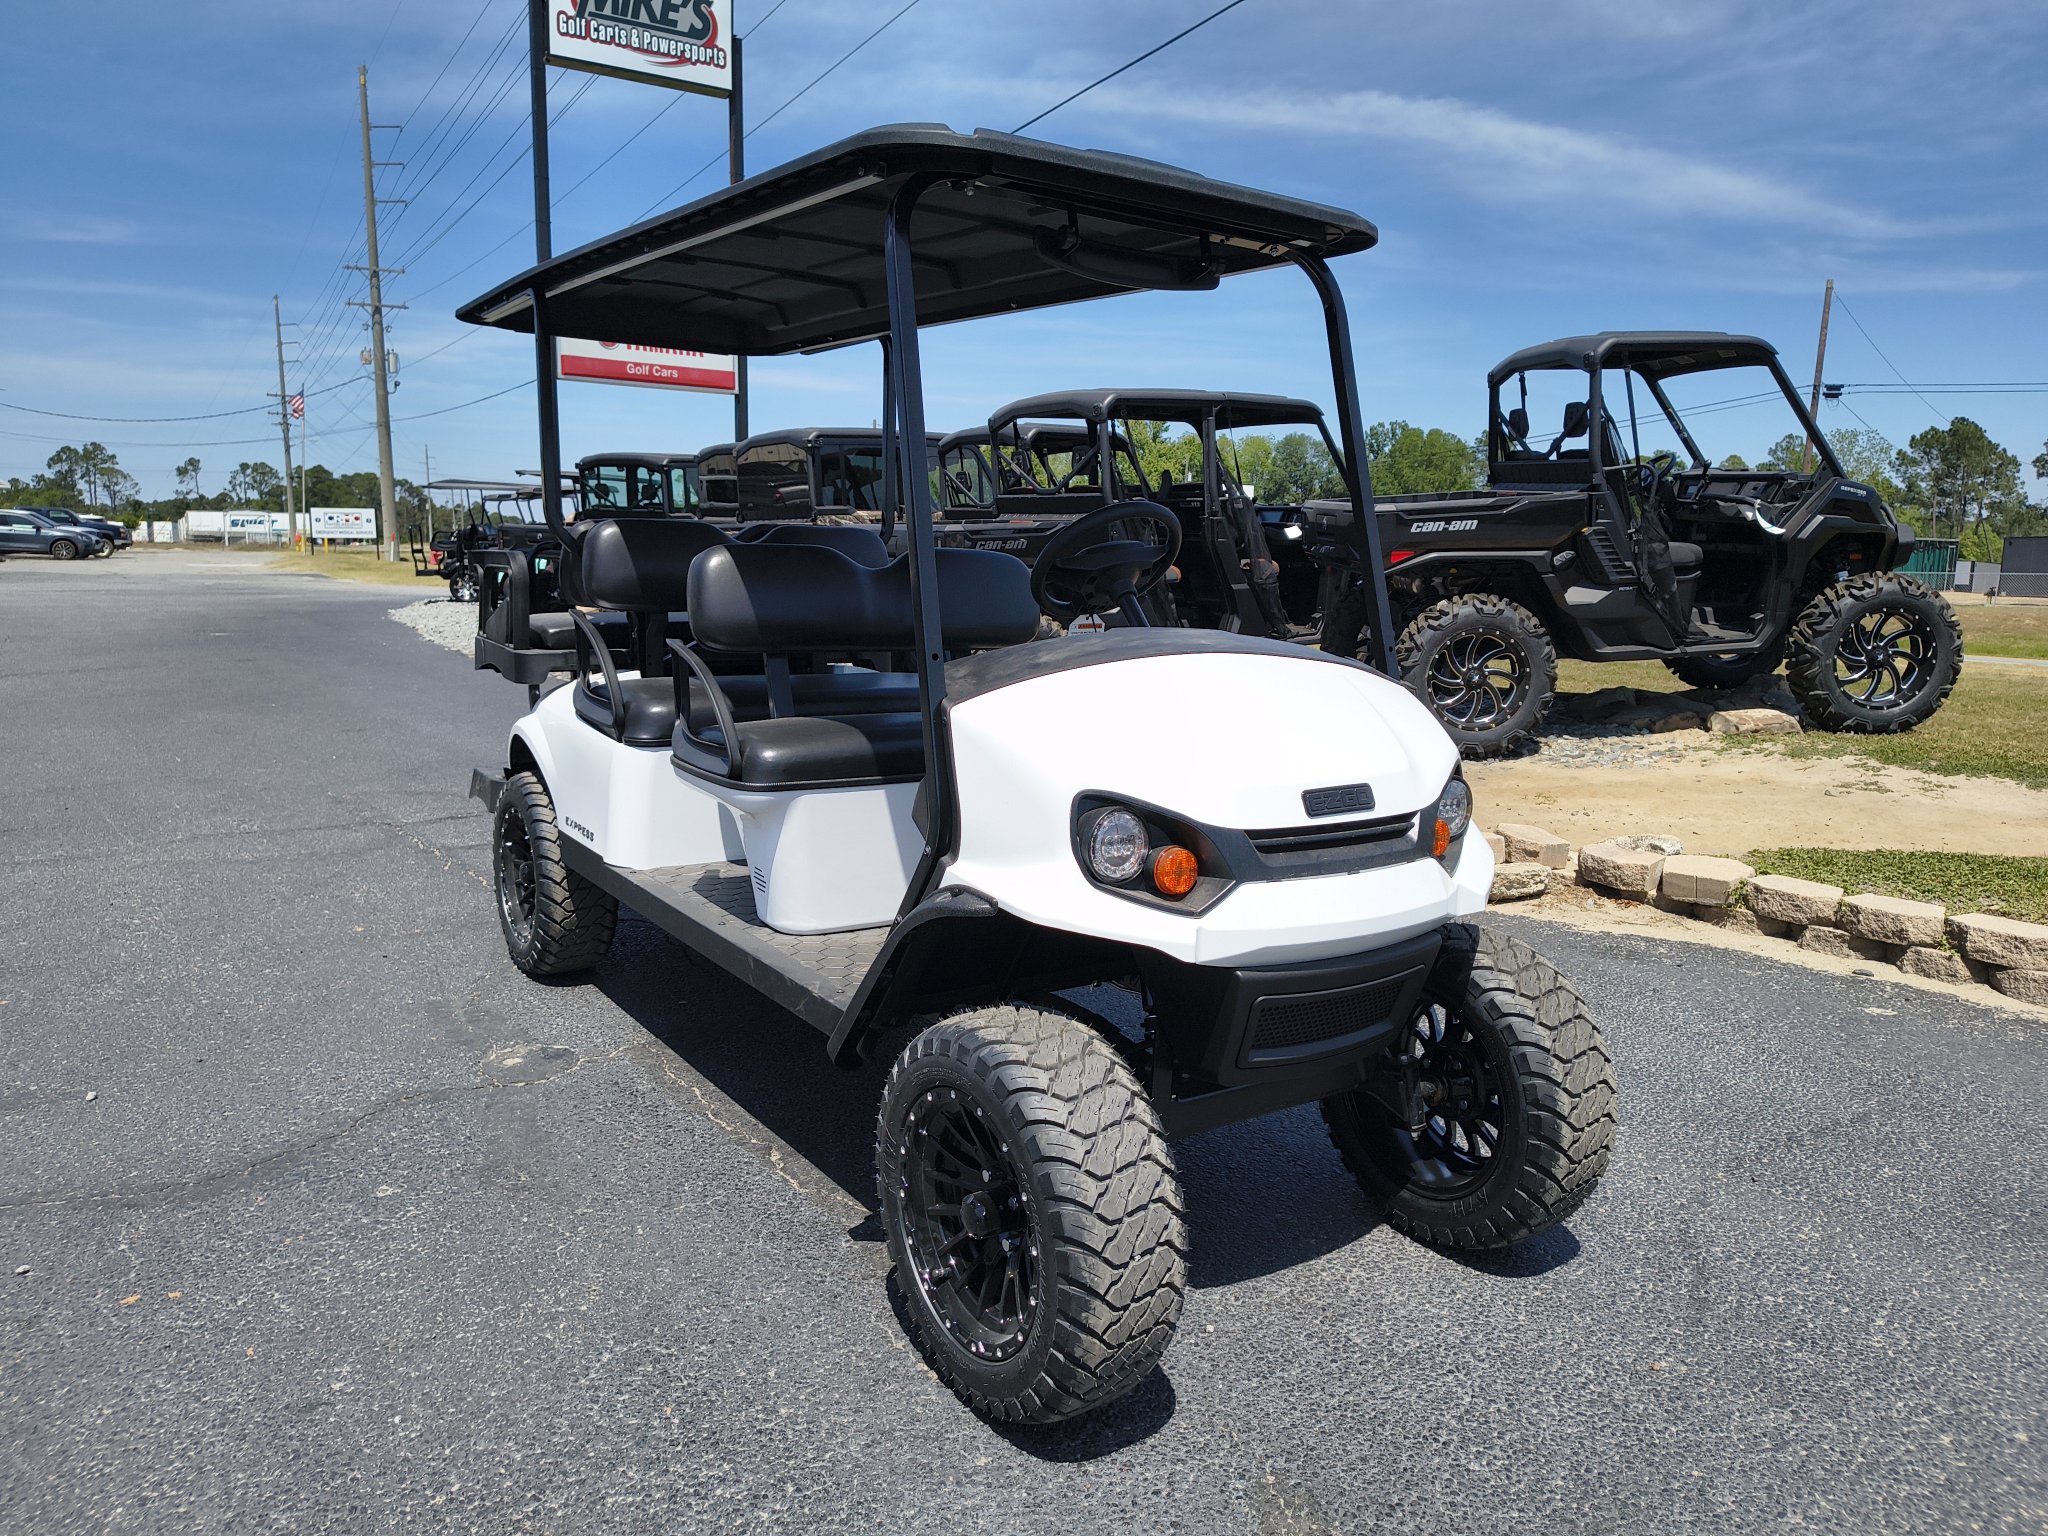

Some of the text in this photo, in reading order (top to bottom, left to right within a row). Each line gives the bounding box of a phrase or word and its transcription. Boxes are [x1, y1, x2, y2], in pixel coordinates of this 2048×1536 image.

[558, 14, 726, 67] Golf Carts & Powersports
[626, 363, 679, 378] Golf Cars
[1410, 520, 1479, 533] can-am
[975, 539, 1028, 551] can-am
[565, 815, 595, 842] EXPRESS
